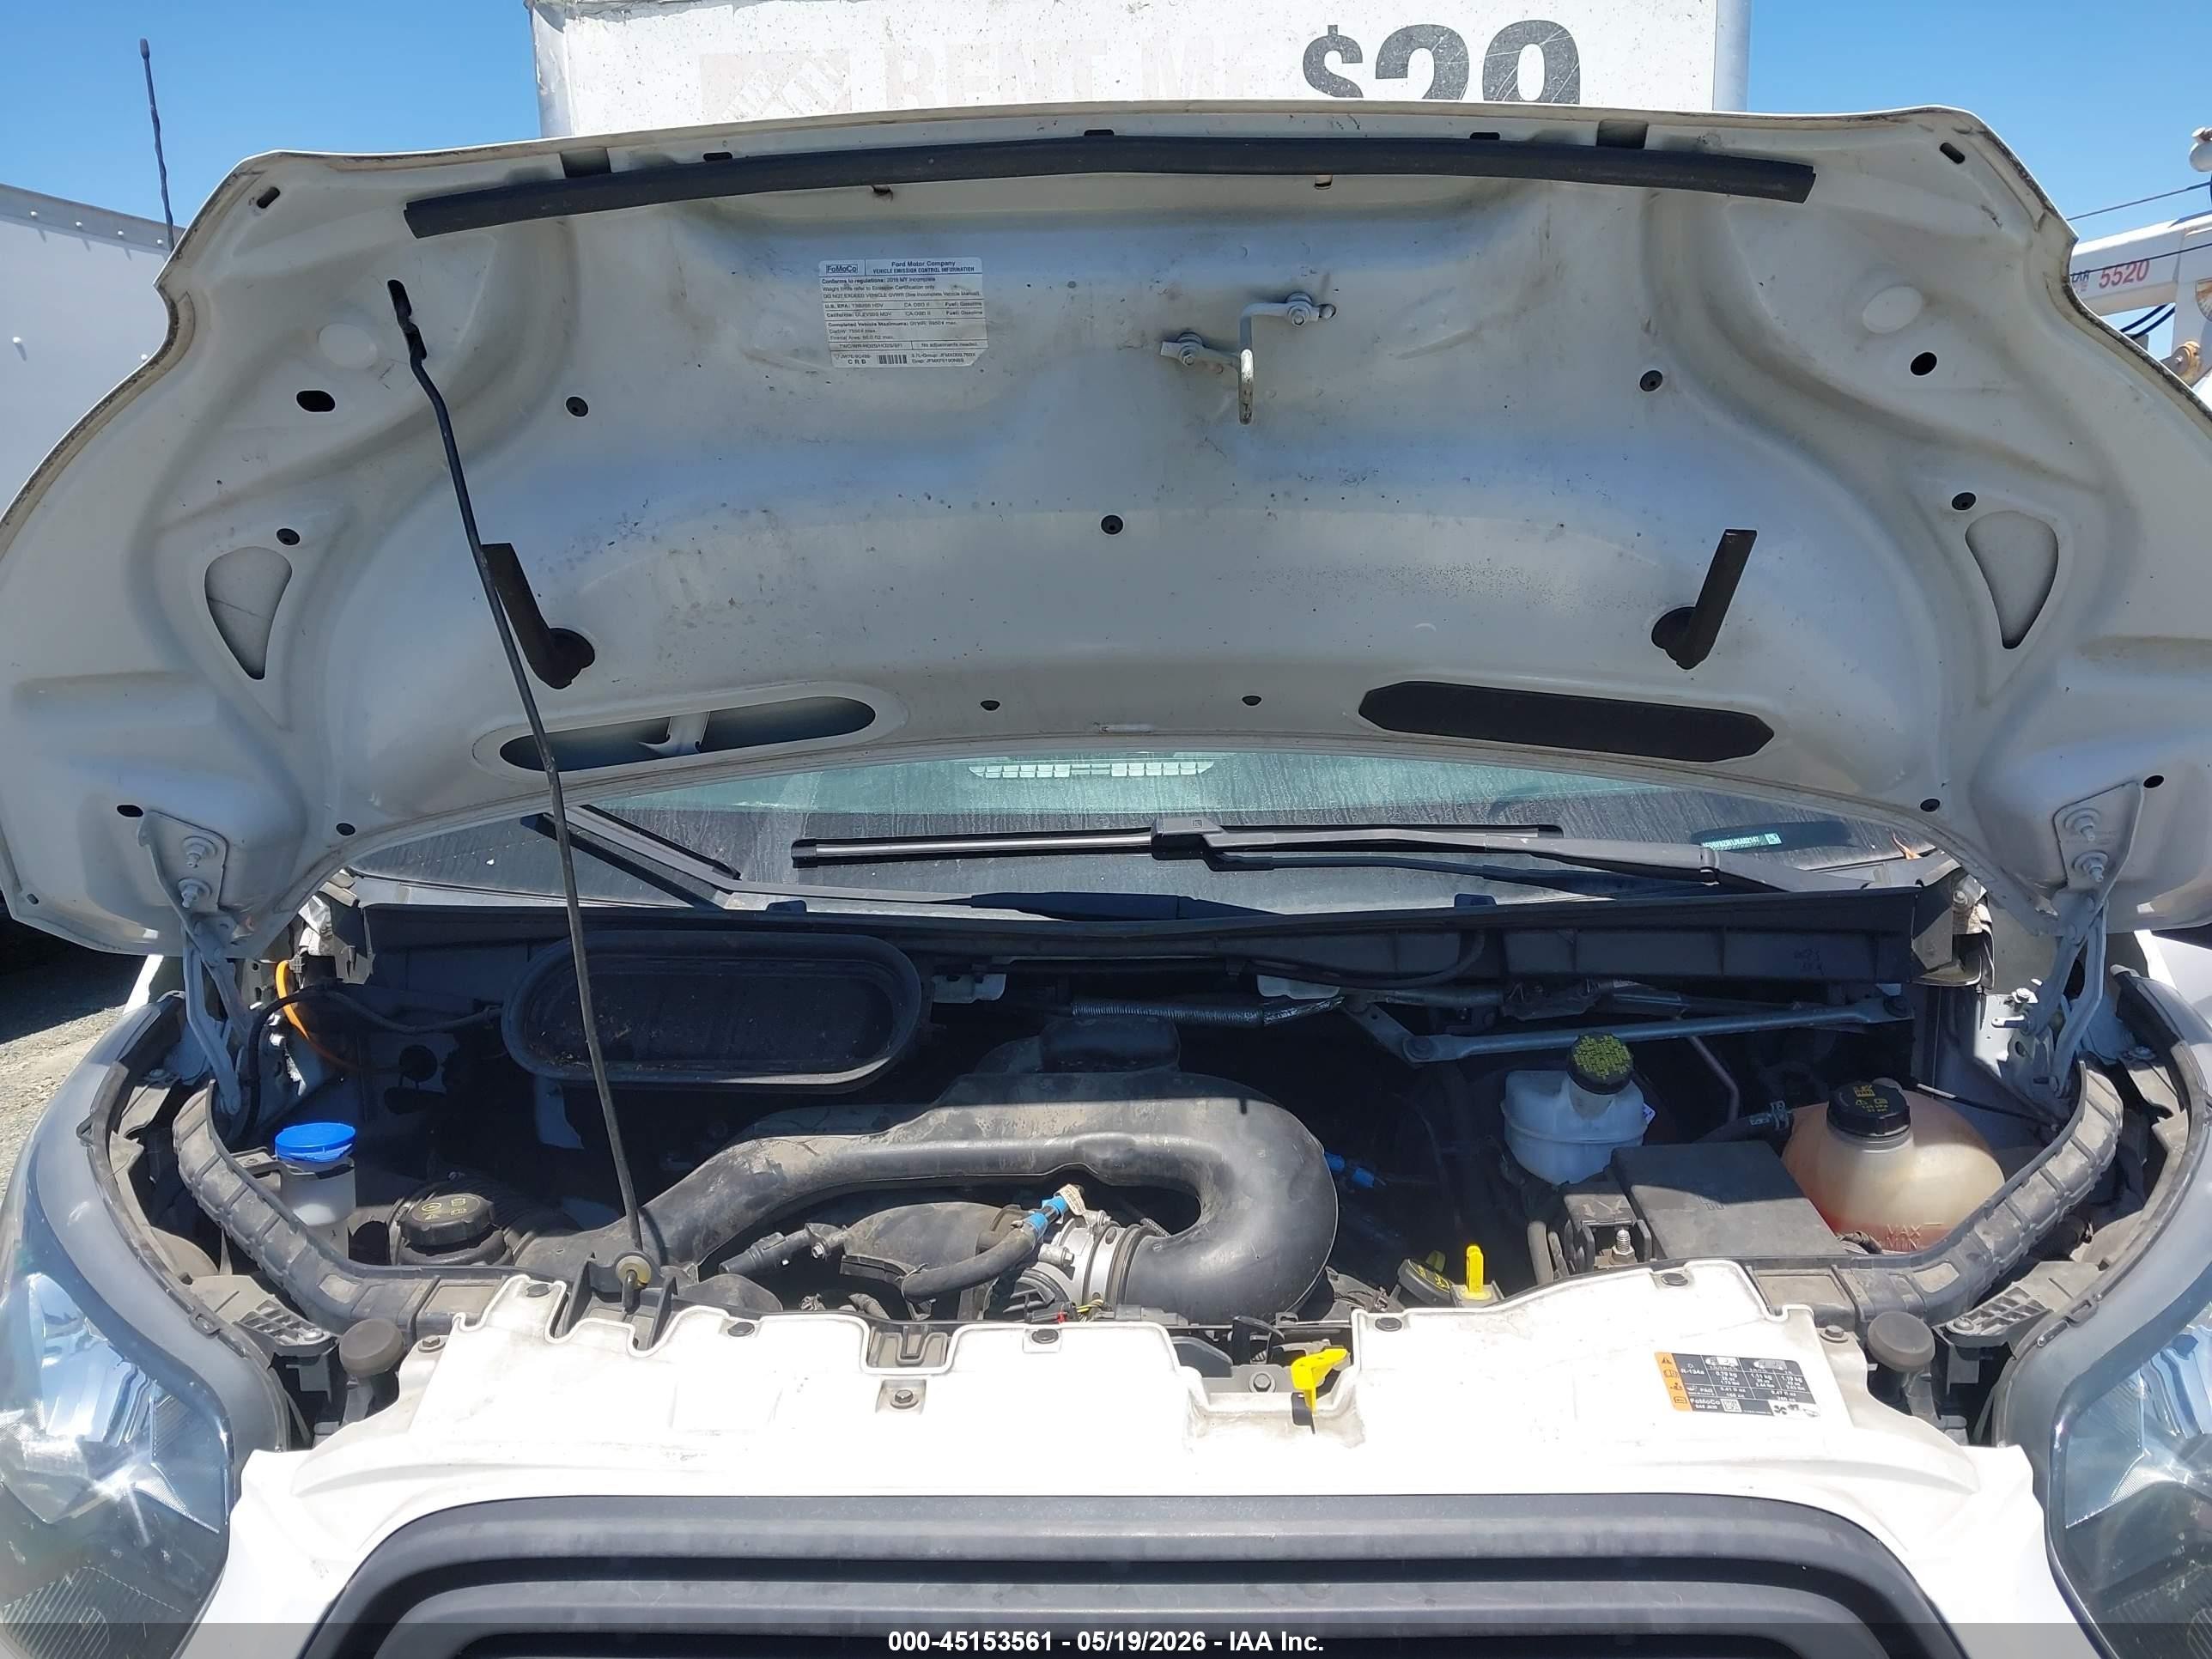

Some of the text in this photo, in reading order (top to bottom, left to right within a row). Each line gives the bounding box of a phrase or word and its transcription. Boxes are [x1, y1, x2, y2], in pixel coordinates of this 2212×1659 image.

[827, 265, 857, 274] FoMoCo
[2099, 260, 2150, 289] 5520
[1690, 1397, 1721, 1406] FoMoCo
